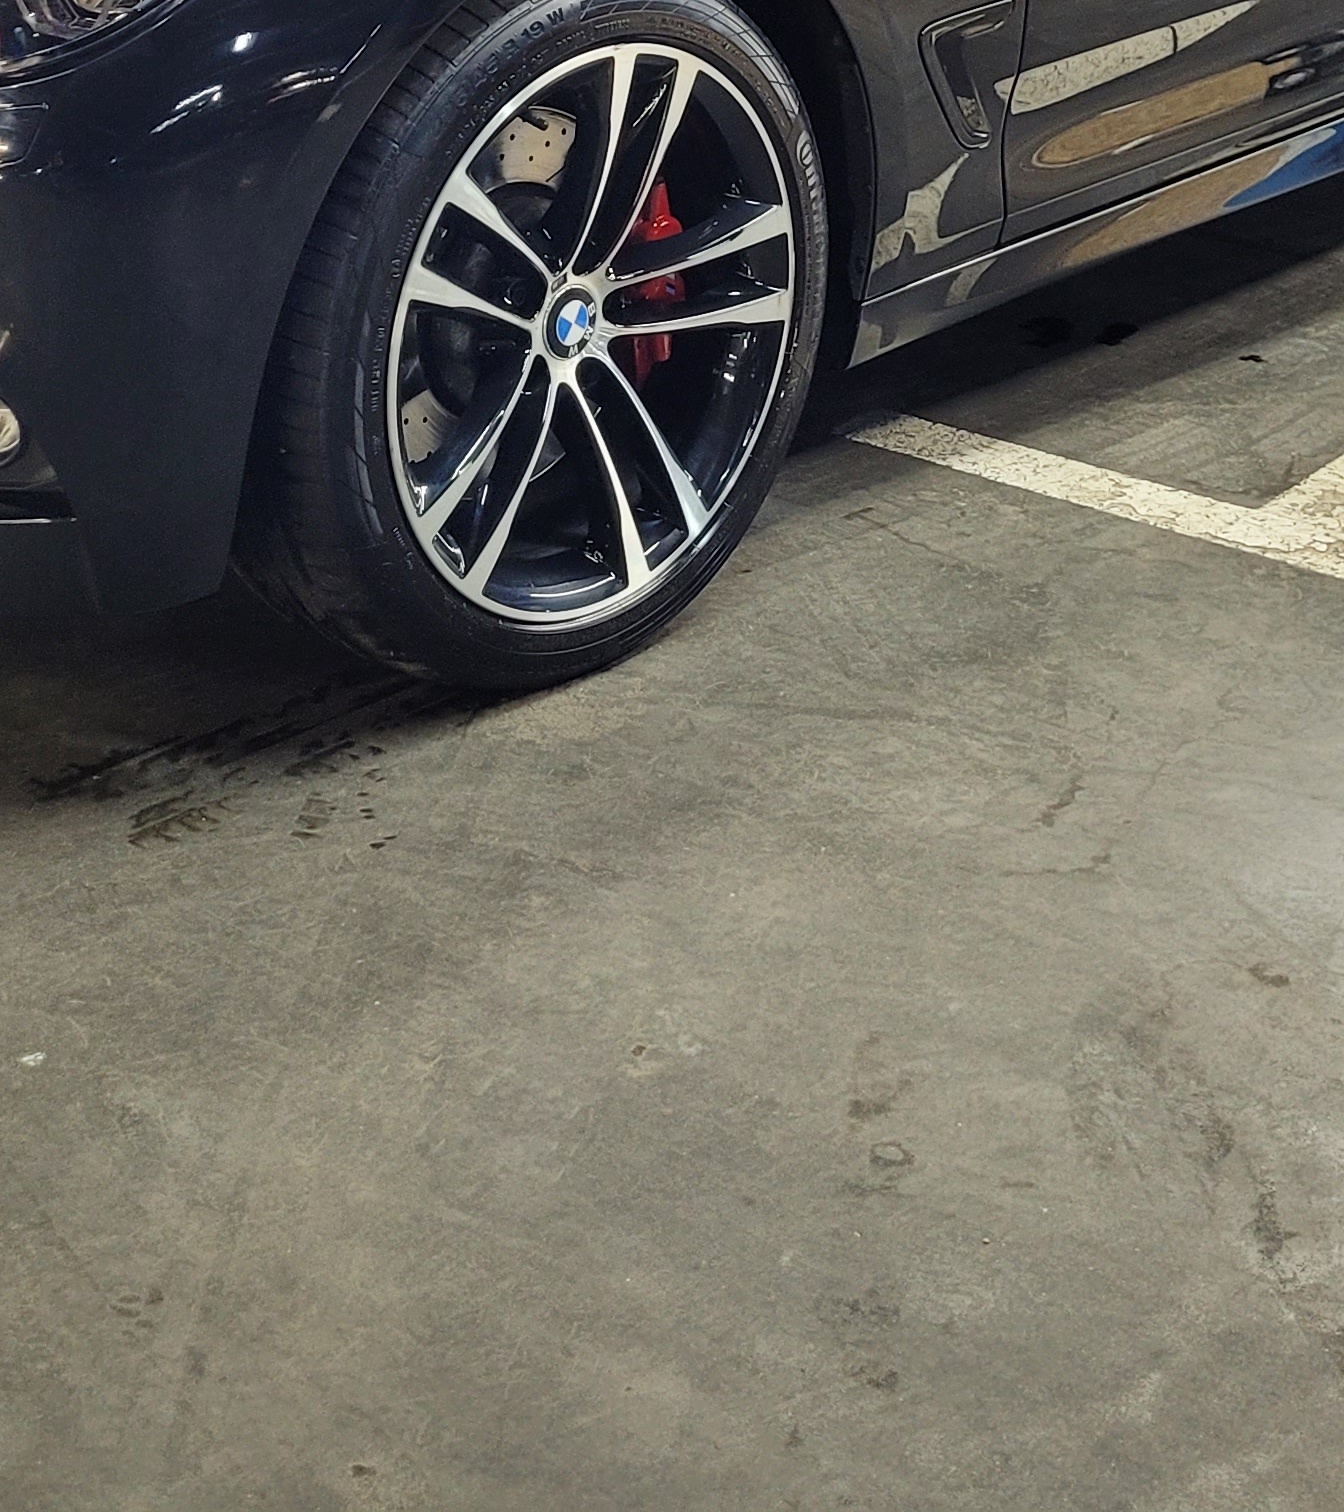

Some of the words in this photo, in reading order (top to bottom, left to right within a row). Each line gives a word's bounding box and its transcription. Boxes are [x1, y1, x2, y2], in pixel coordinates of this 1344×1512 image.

[521, 20, 546, 40] 19
[546, 7, 565, 26] W
[568, 302, 597, 358] BMW
